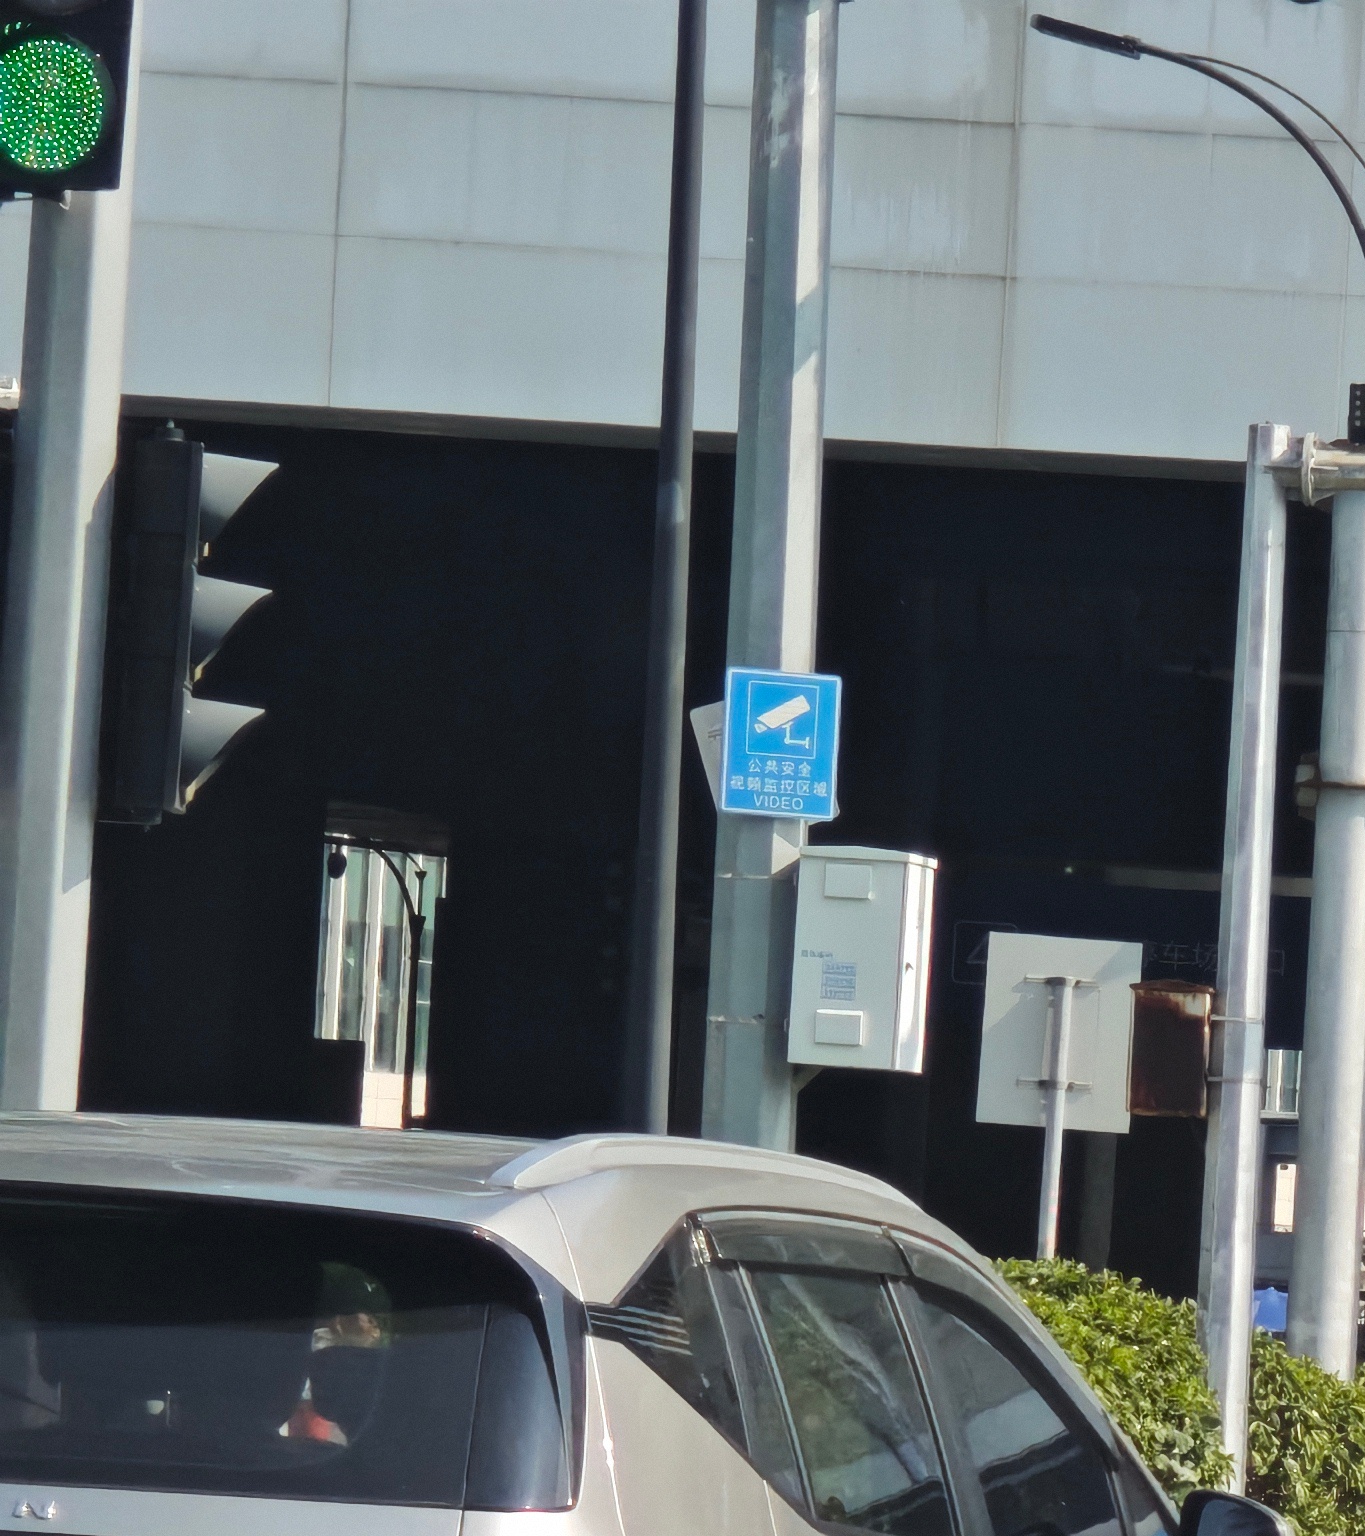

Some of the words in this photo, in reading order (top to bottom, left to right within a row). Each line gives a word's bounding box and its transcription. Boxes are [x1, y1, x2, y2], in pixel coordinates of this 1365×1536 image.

[748, 758, 811, 777] 公共安全
[753, 793, 804, 810] VIDEO
